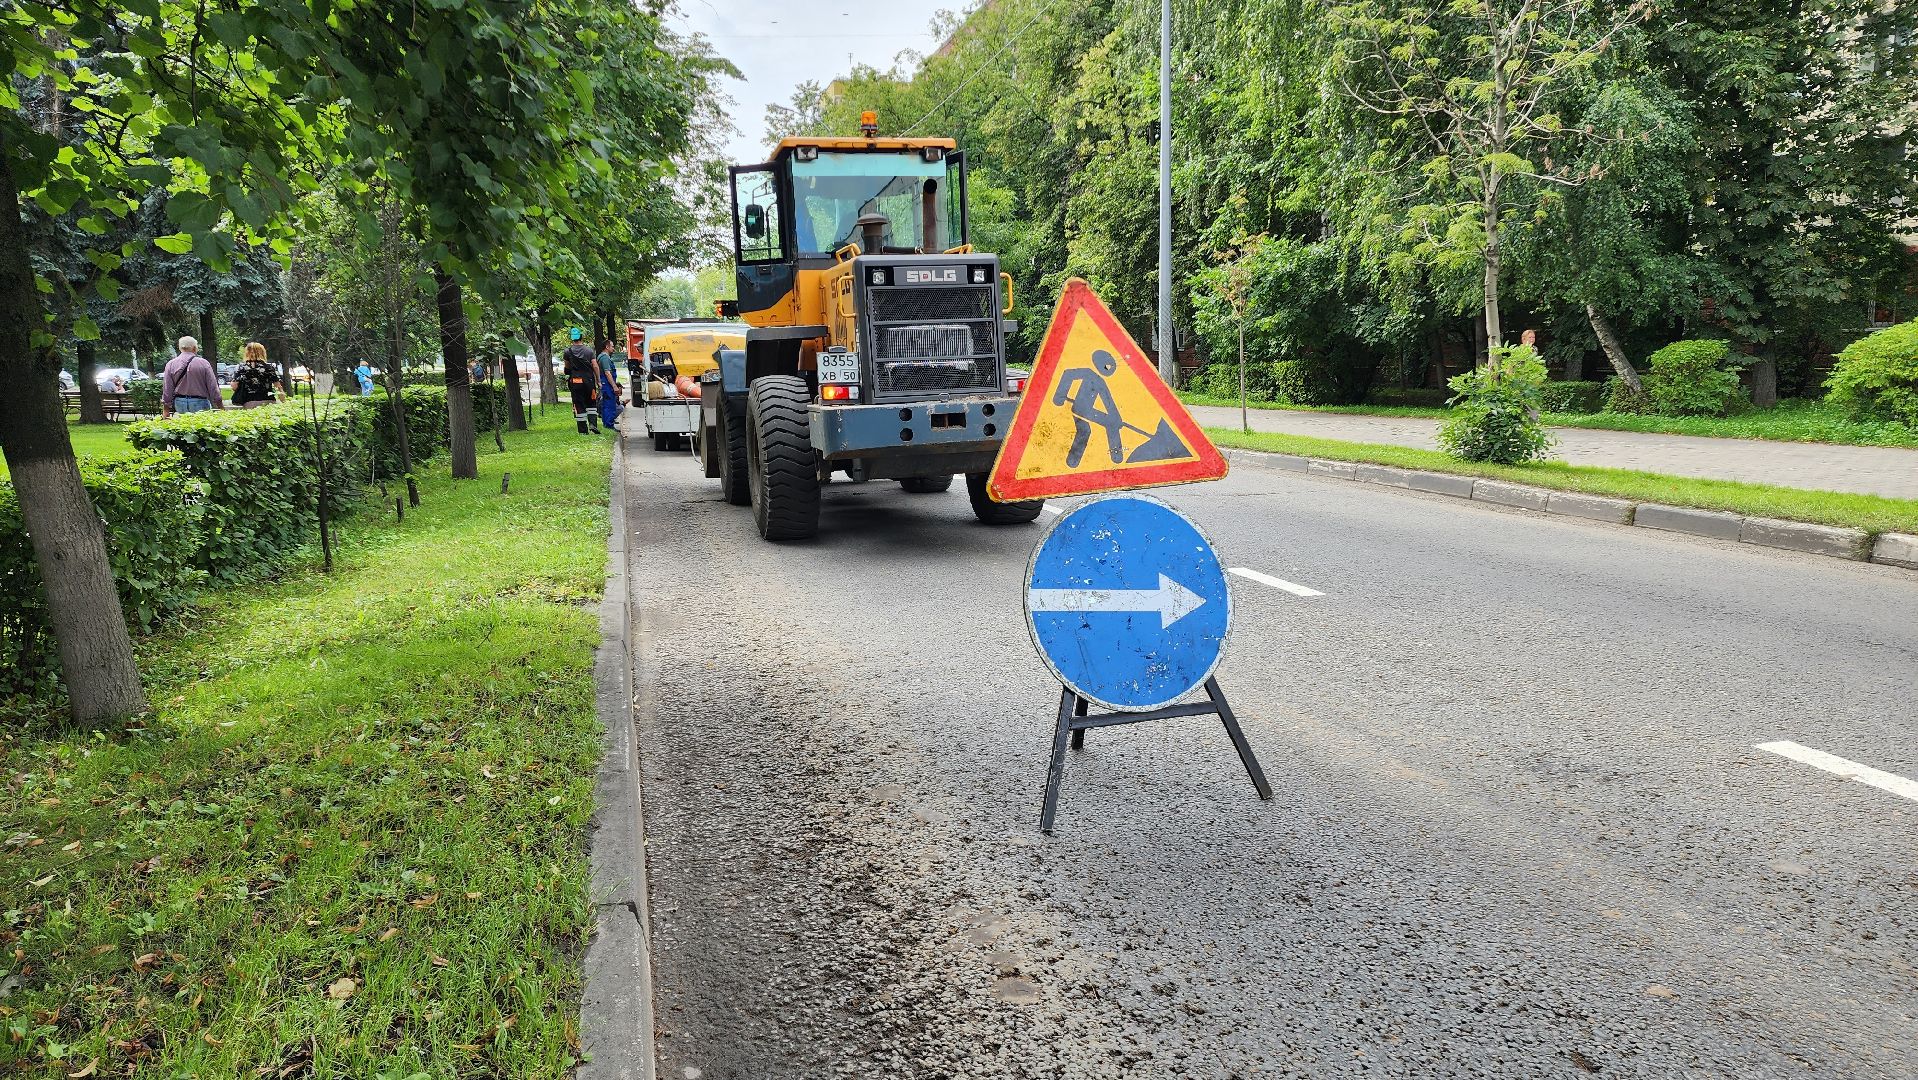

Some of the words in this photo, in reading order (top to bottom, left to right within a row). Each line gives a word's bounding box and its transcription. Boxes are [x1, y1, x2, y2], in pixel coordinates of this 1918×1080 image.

[906, 269, 957, 283] SDLG
[822, 354, 854, 367] 8355
[843, 371, 856, 381] 50
